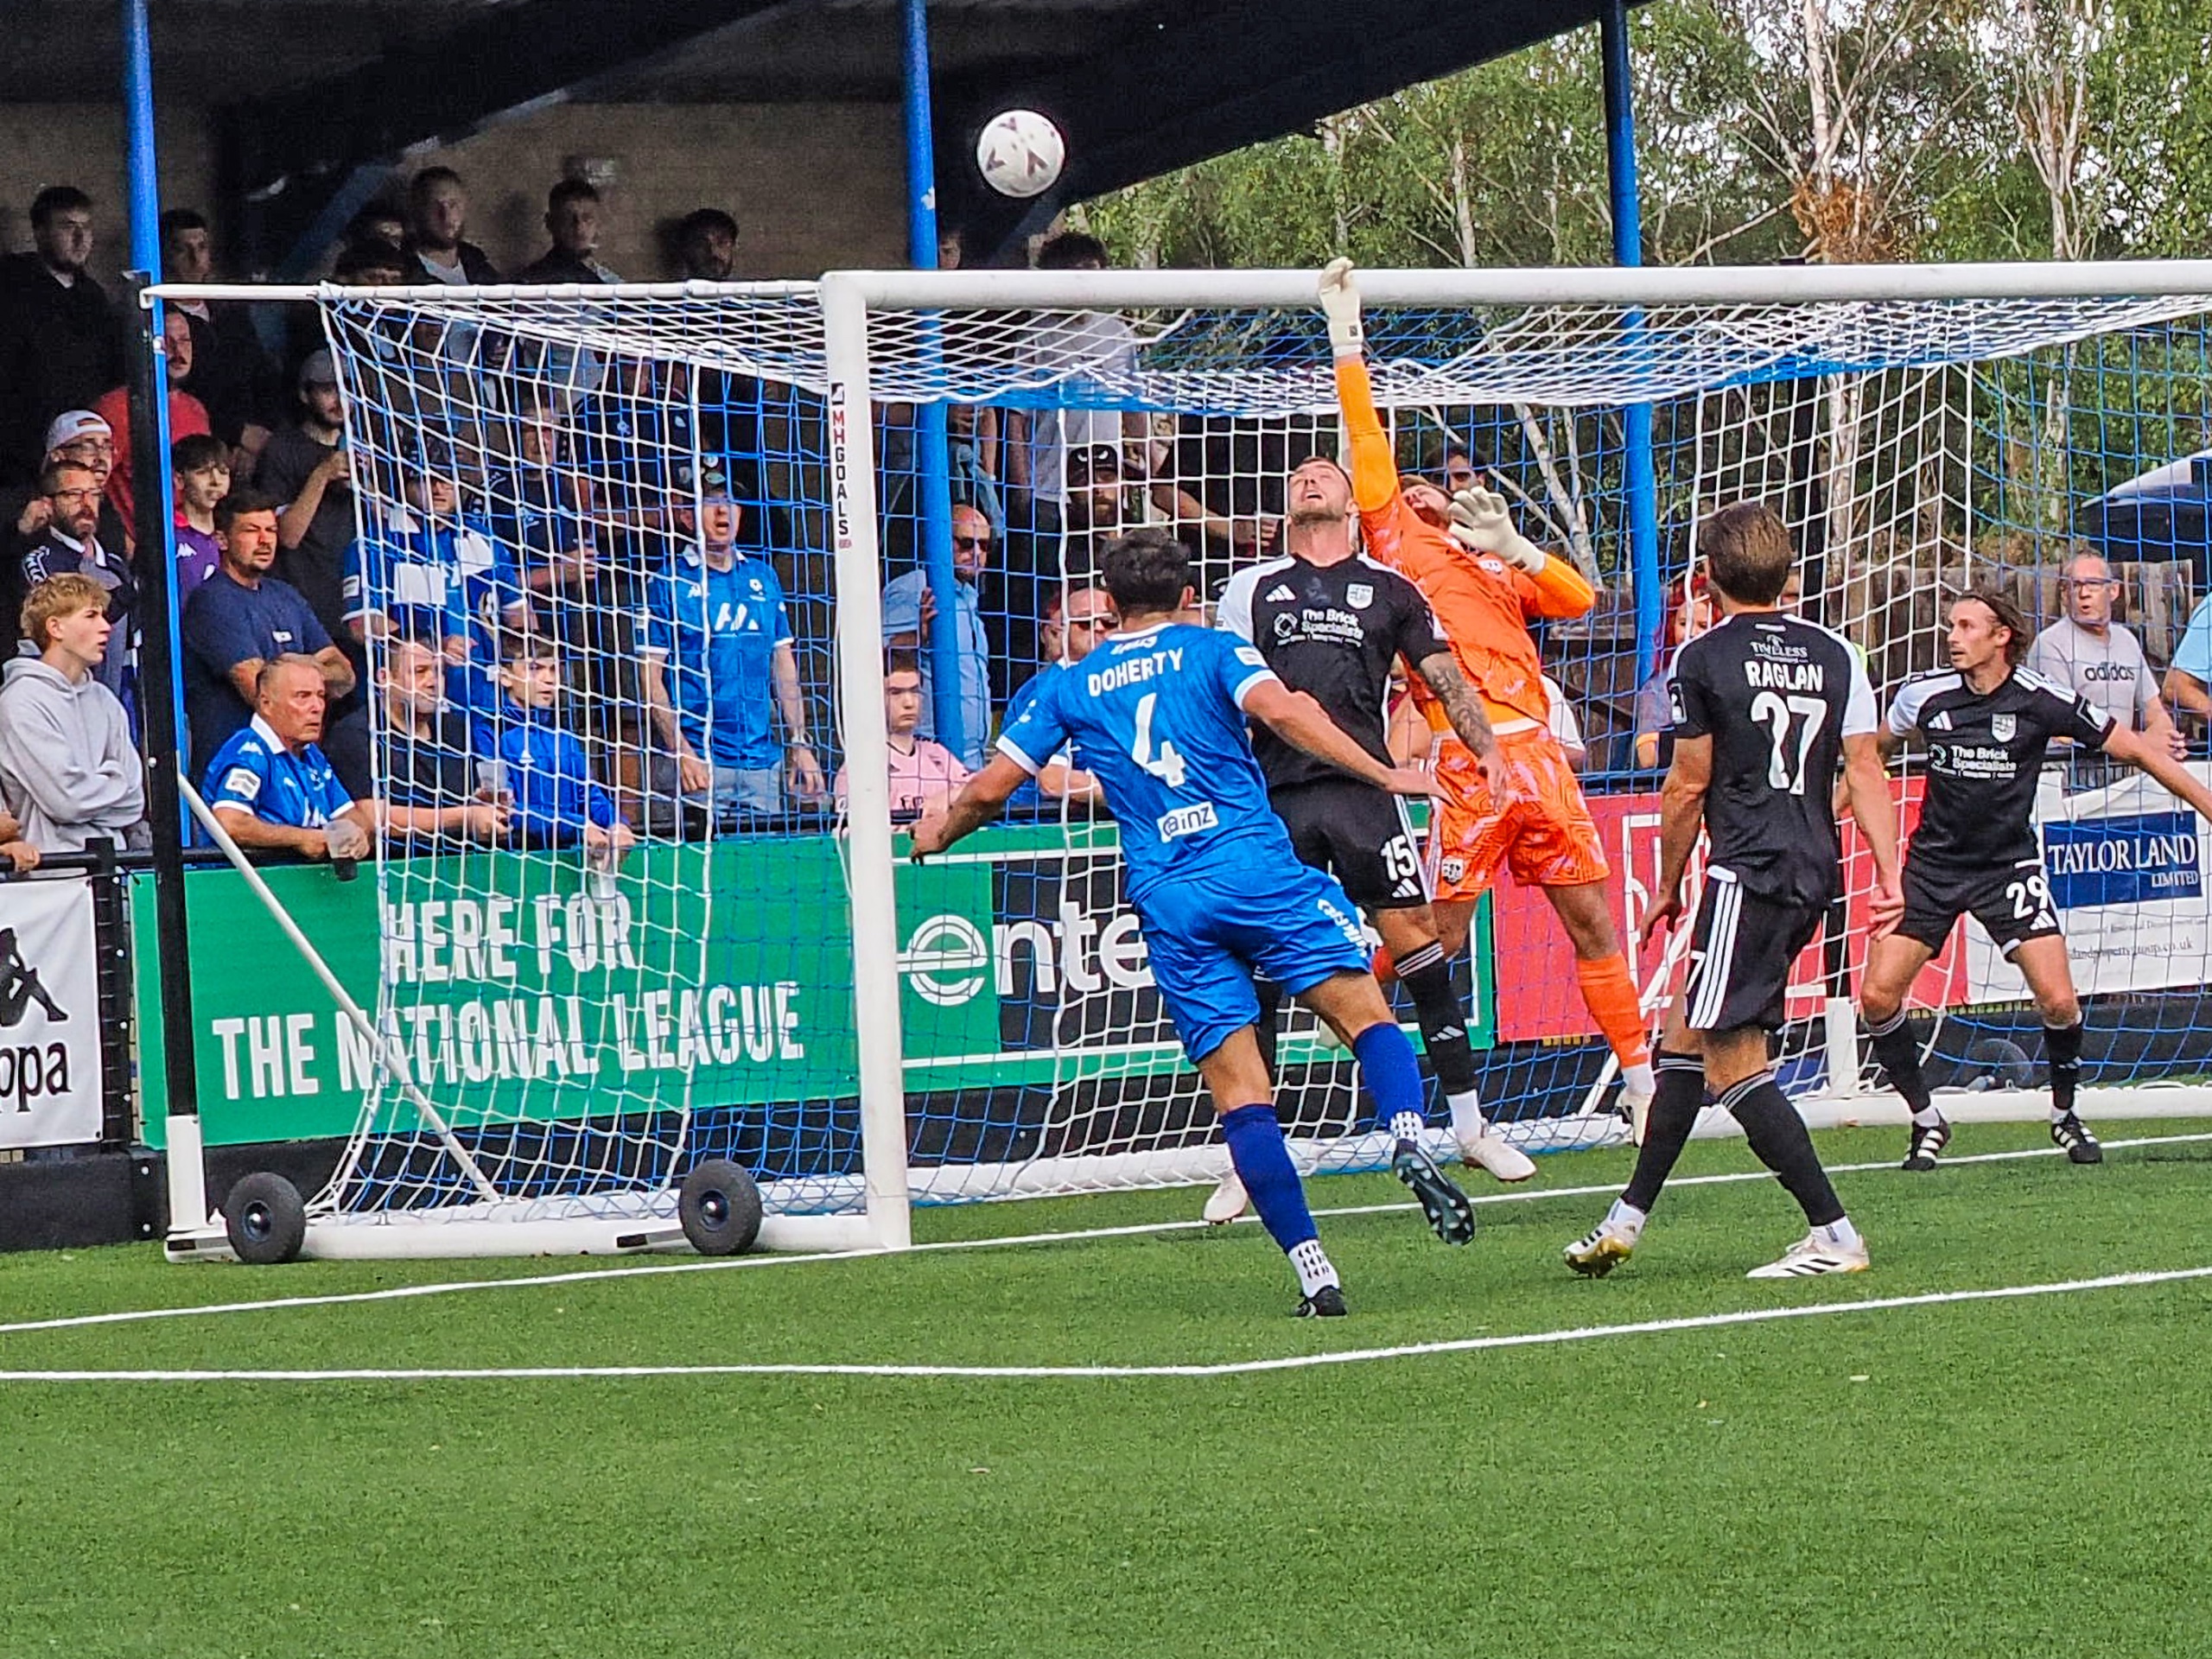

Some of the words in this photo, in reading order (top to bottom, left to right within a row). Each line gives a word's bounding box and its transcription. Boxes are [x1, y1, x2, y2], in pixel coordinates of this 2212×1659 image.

[1302, 607, 1325, 621] The
[1325, 608, 1359, 626] Brick
[1088, 647, 1184, 697] DOHERTY
[1744, 660, 1824, 692] RAGLAN
[1132, 692, 1186, 788] 4
[1751, 690, 1827, 796] 27
[1950, 745, 1975, 759] The
[1976, 747, 2009, 760] Brick
[1953, 757, 2017, 772] Specialists
[1380, 835, 1417, 881] 15
[2048, 839, 2133, 875] TAYLOR
[2134, 834, 2197, 869] LAND
[2006, 874, 2049, 919] 29
[2152, 870, 2199, 888] LIMITED
[386, 897, 517, 983] HERE
[535, 893, 636, 975] FOR
[212, 1014, 319, 1100] THE
[335, 995, 600, 1092] NATIONAL
[613, 980, 804, 1071] LEAGUE
